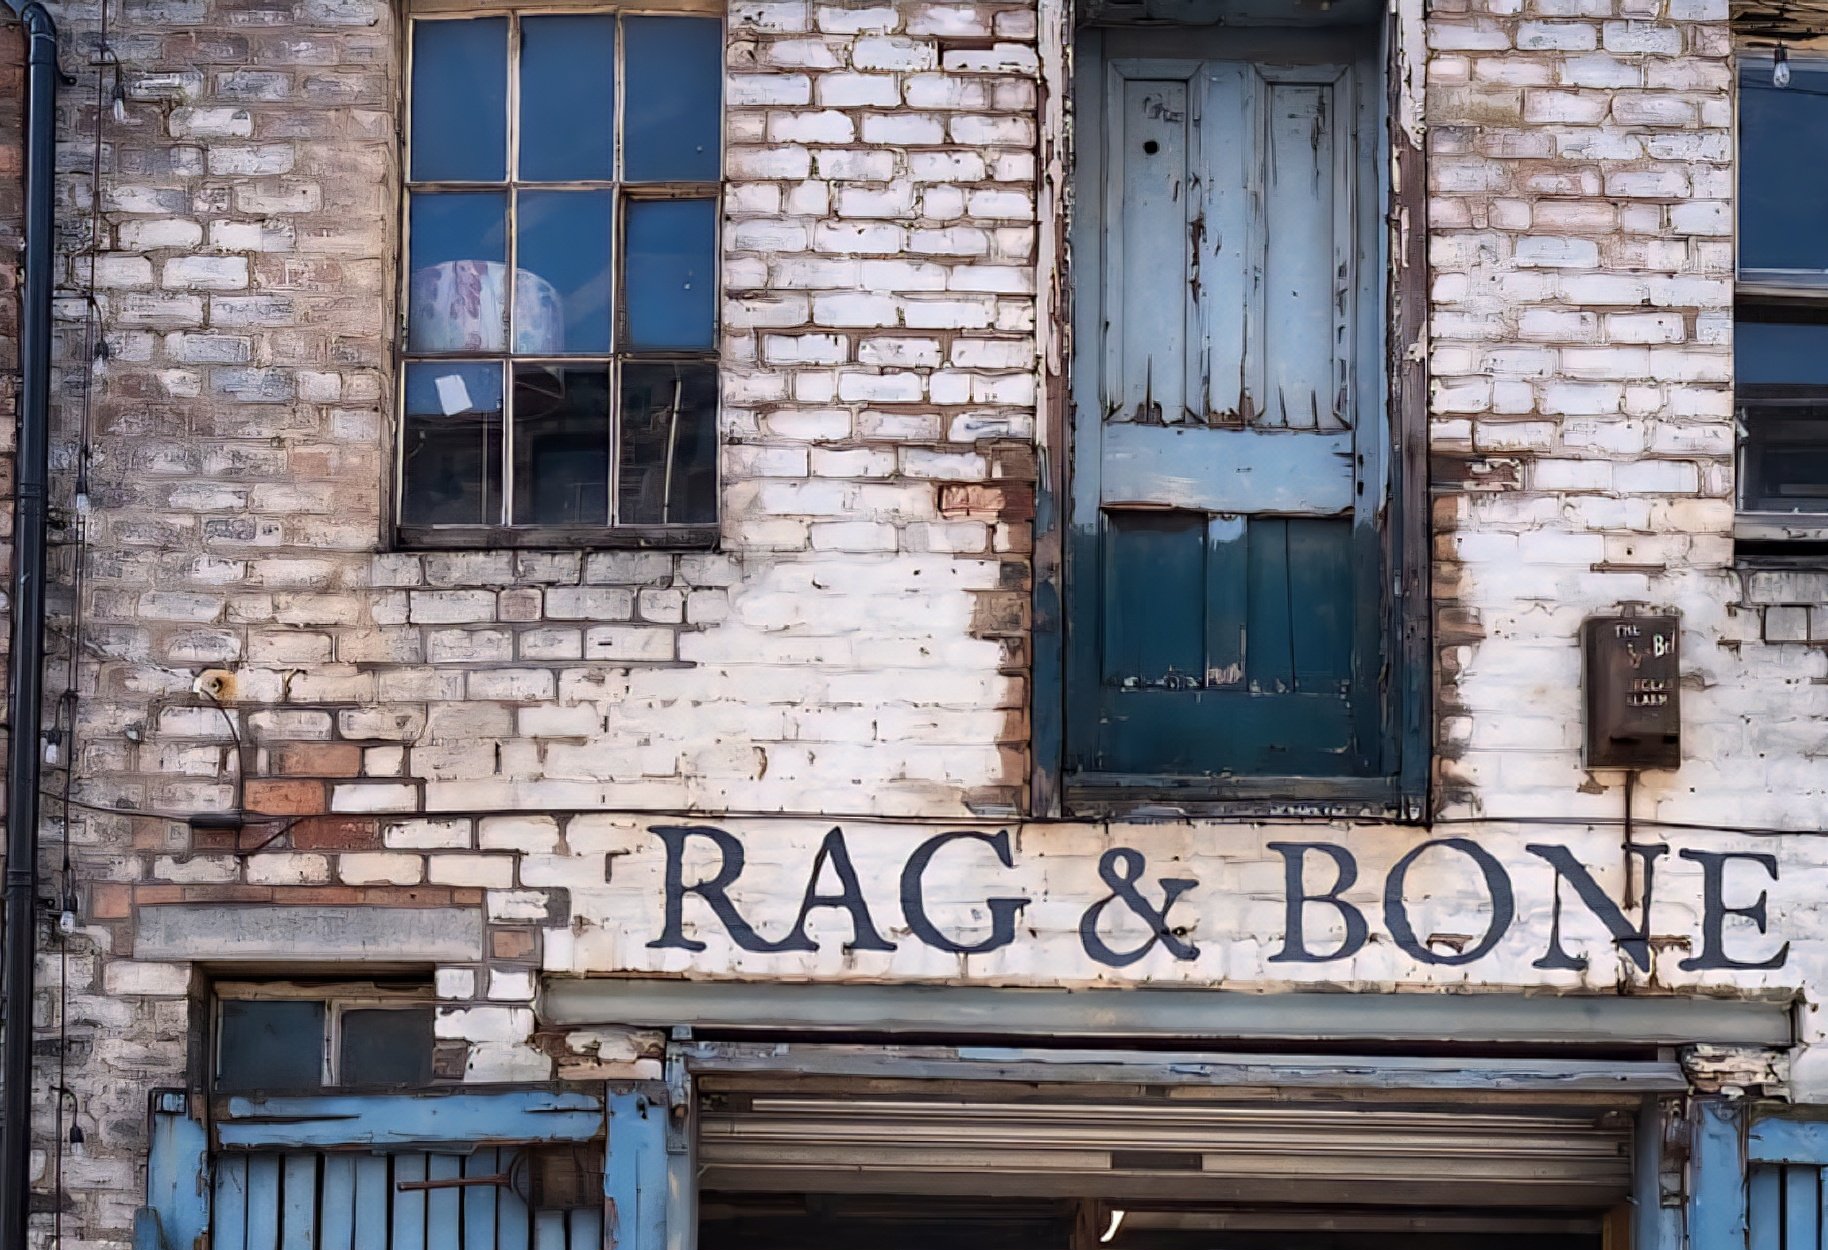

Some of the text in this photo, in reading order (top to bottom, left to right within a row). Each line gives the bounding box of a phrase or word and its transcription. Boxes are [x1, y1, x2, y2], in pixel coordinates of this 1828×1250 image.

[644, 825, 1792, 972] RAG & BONE
